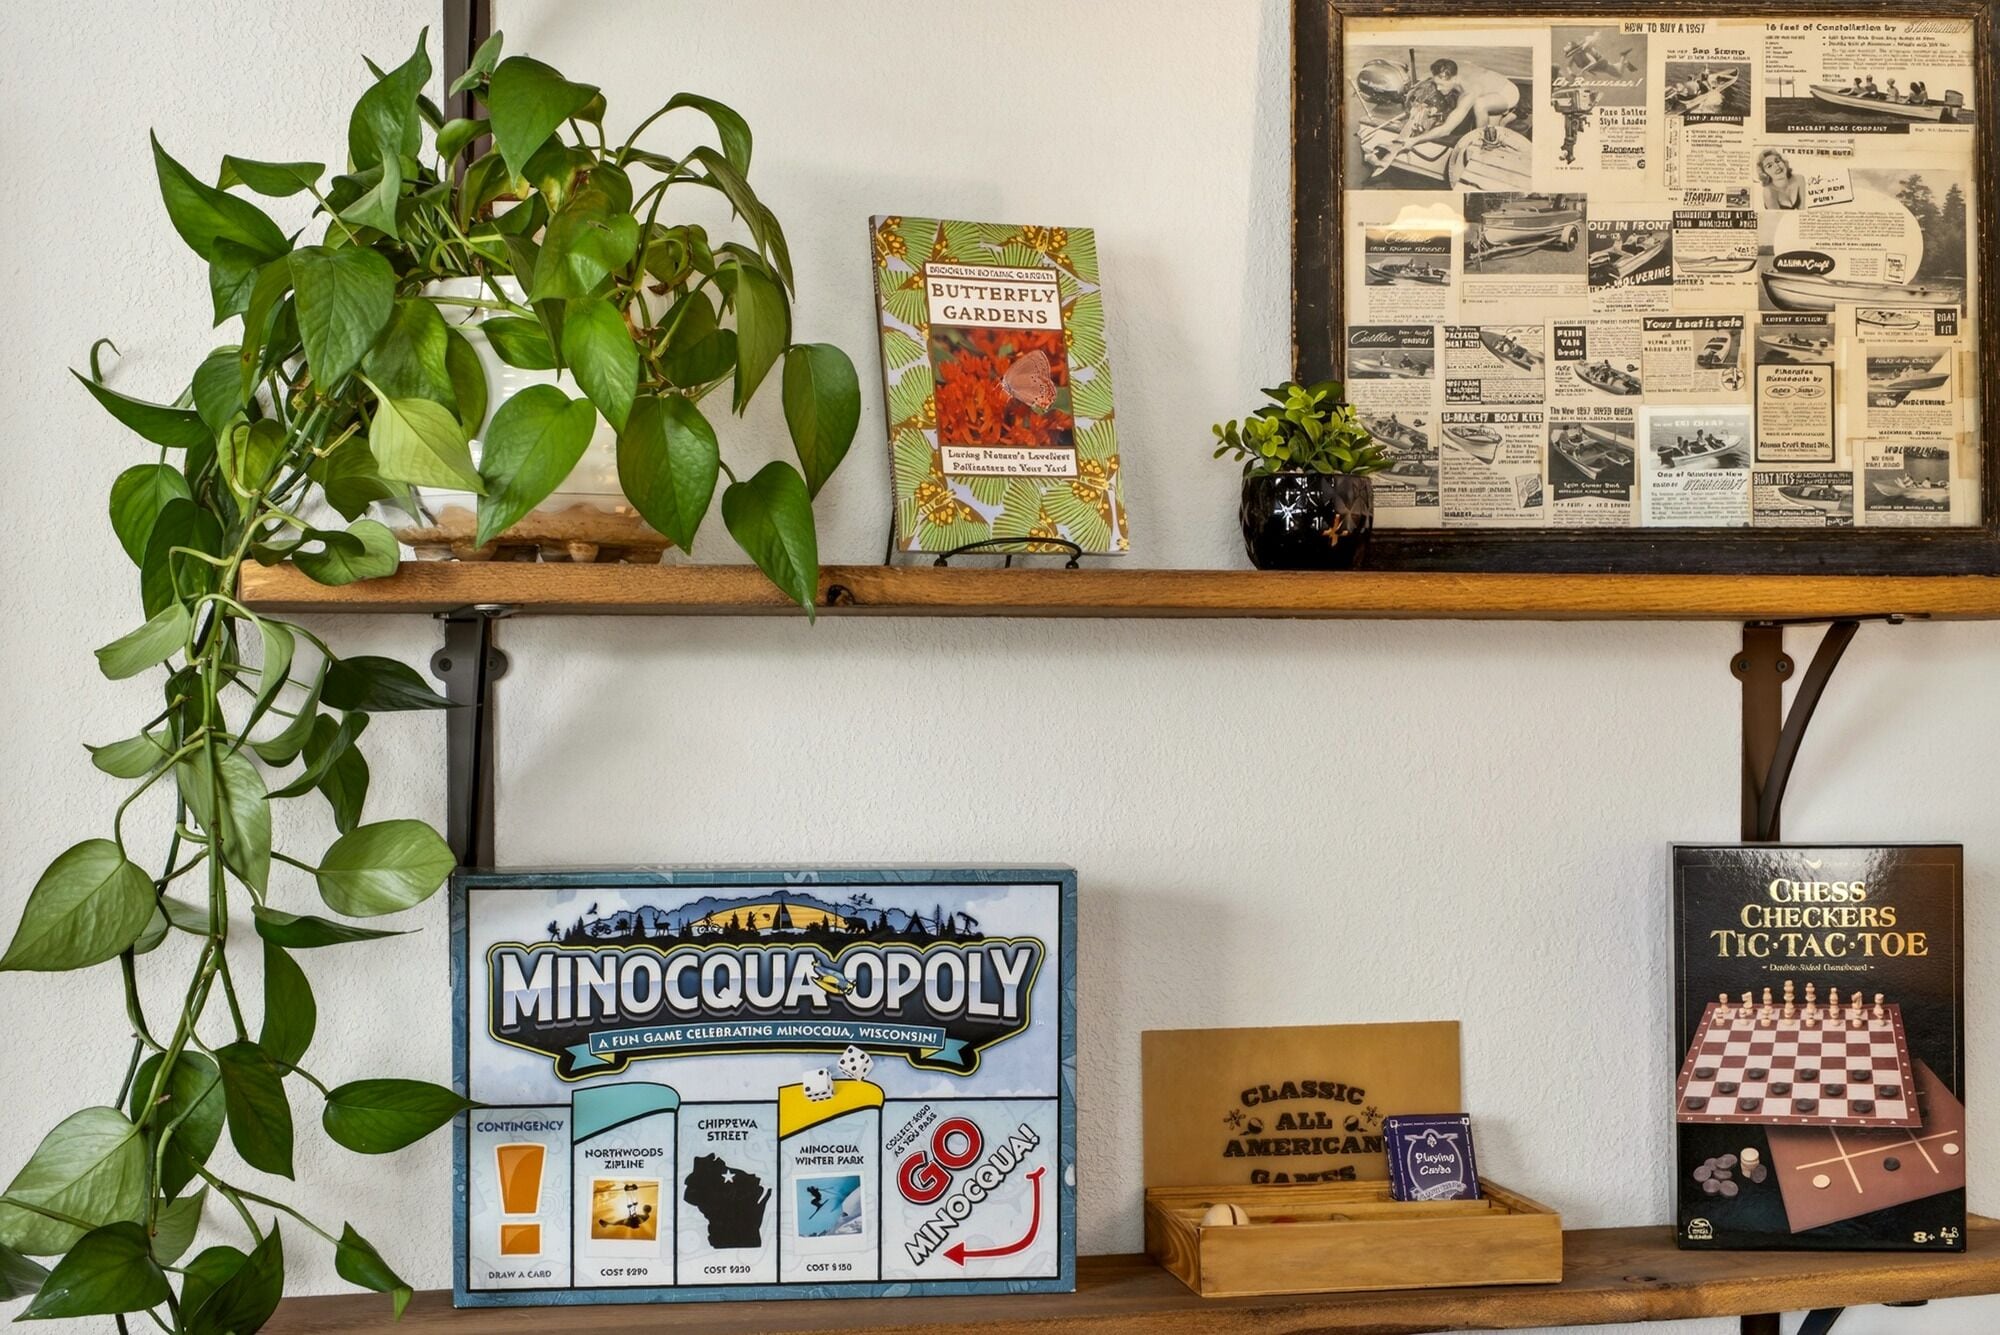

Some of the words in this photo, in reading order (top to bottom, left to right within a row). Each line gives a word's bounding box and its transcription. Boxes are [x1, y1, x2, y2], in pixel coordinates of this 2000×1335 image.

[1588, 221, 1610, 231] OUT
[1615, 221, 1629, 231] IN
[1632, 221, 1671, 231] FRONT
[931, 283, 1055, 303] BUTTERFLY
[943, 305, 1048, 324] GARDENS
[1645, 319, 1673, 329] Your
[1675, 318, 1703, 329] boat
[948, 449, 981, 460] Luring
[983, 450, 1025, 460] Nature's
[1028, 451, 1070, 460] Loveliest
[953, 462, 1005, 472] Pollinators
[1007, 462, 1017, 472] to
[1019, 464, 1042, 472] Your
[1044, 464, 1067, 473] Yard
[1769, 878, 1867, 903] CHESS
[1740, 904, 1897, 929] CHECKERS
[598, 1038, 609, 1049] A
[612, 1034, 639, 1047] FUN
[643, 1030, 683, 1043] GAME
[686, 1026, 772, 1039] CELEBRATING
[776, 1025, 855, 1039] MINOCQUA,
[859, 1027, 938, 1043] WISCONSIN!
[1241, 1080, 1365, 1107] CLASSIC
[476, 1120, 564, 1133] CONTINGENCY
[697, 1118, 758, 1130] CHIPPEWA
[1275, 1111, 1333, 1131] ALL
[707, 1131, 749, 1142] STREET
[800, 1144, 860, 1155] MINOCQUA
[1223, 1134, 1384, 1158] AMERICAN
[584, 1148, 664, 1159] NORTHWOODS
[1415, 1152, 1455, 1164] Playing
[604, 1159, 645, 1170] ZIPLINE
[795, 1156, 834, 1166] WINTER
[837, 1155, 864, 1165] PARK
[897, 1117, 985, 1204] GO
[1419, 1165, 1451, 1176] Cards
[904, 1123, 1041, 1266] MINOCQUA!
[600, 1268, 623, 1277] COST
[703, 1265, 727, 1274] COST
[806, 1263, 830, 1272] COST
[488, 1270, 515, 1279] DRAW
[518, 1270, 525, 1279] A
[527, 1269, 552, 1279] CARD
